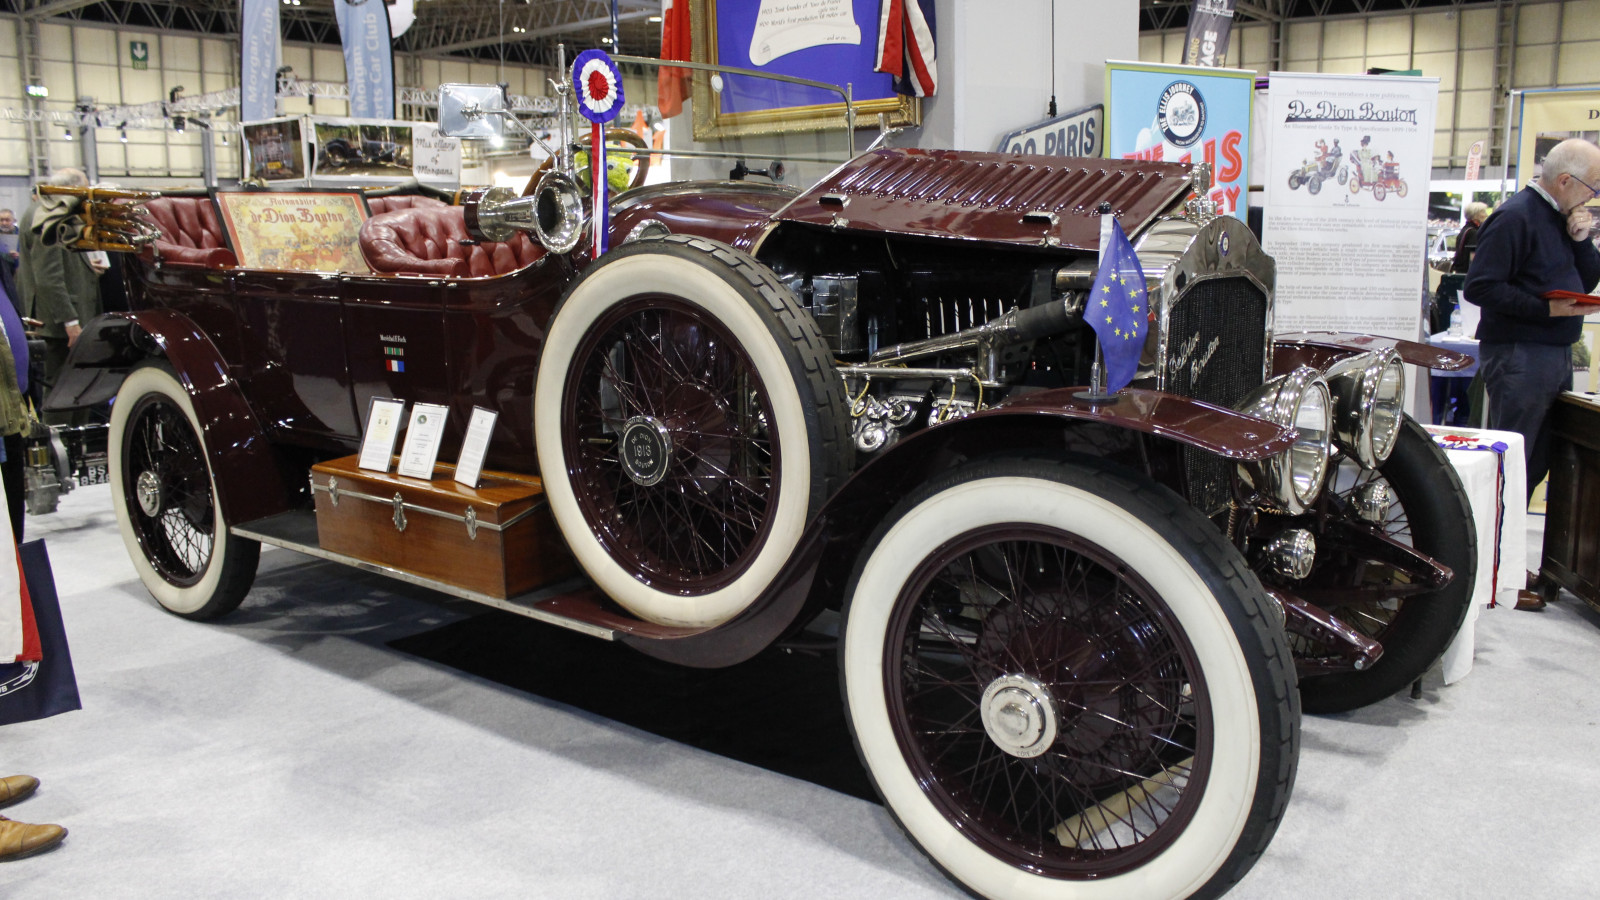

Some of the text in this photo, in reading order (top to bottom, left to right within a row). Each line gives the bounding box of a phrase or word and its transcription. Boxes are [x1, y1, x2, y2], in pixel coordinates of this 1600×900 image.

[262, 7, 274, 46] Club
[364, 12, 379, 50] Club
[248, 35, 260, 102] Morgan
[354, 46, 367, 111] Morgan
[370, 56, 383, 85] Car
[1159, 83, 1194, 132] THE ELLIS JOURNEY
[1288, 100, 1417, 125] De Dion Bouton
[1045, 117, 1095, 157] PARIS
[634, 445, 652, 457] 1913
[640, 433, 652, 443] DION
